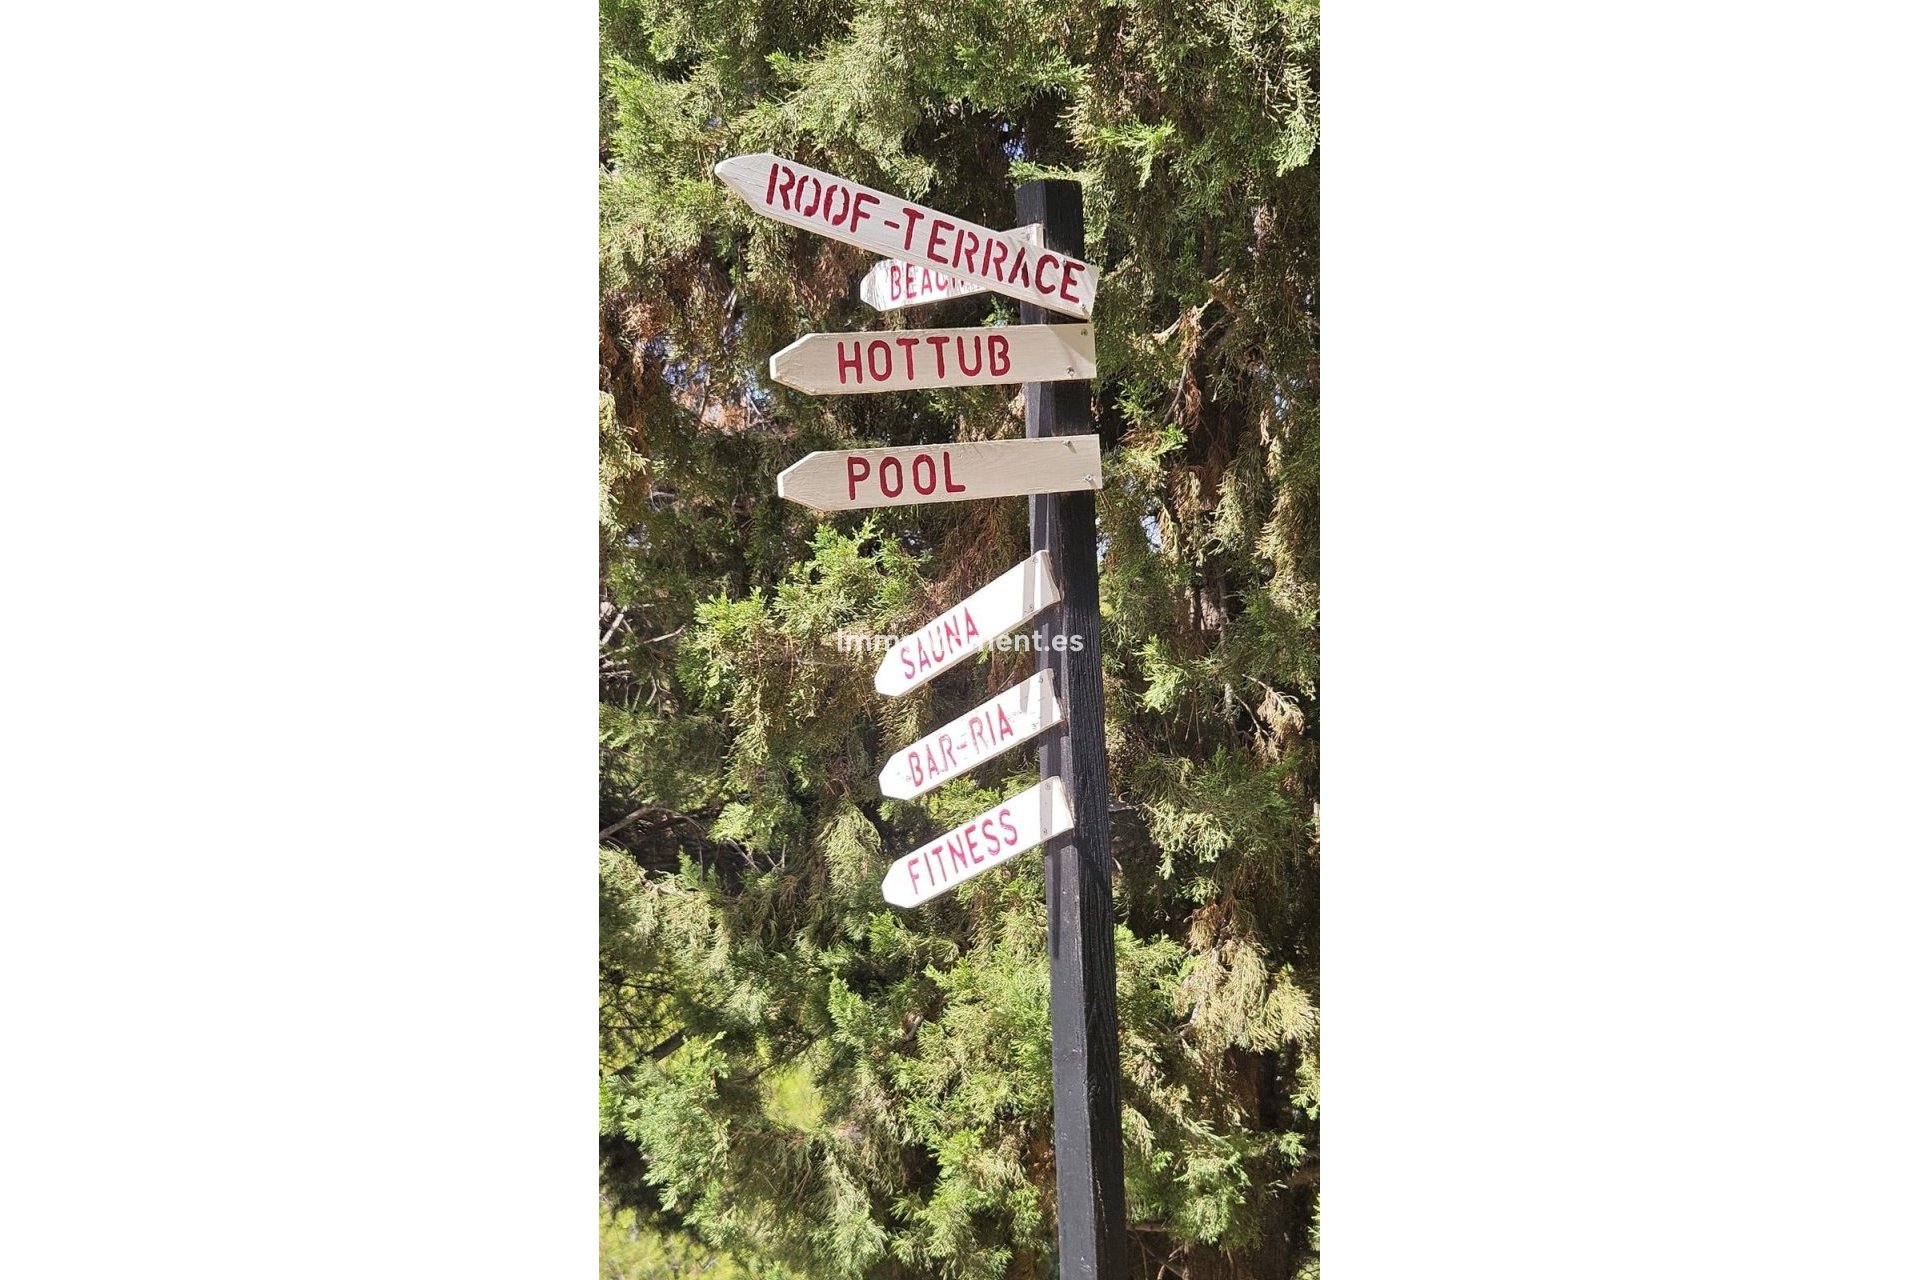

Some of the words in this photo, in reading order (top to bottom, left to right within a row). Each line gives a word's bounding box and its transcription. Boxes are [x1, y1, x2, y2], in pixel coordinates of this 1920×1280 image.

[766, 163, 1085, 303] ROOF-TERRACE
[837, 334, 1011, 384] HOTTUB
[847, 451, 966, 500] POOL
[900, 606, 980, 680] SAUNA
[908, 703, 1014, 788] BAR-RIA
[907, 808, 1018, 895] FITNESS
